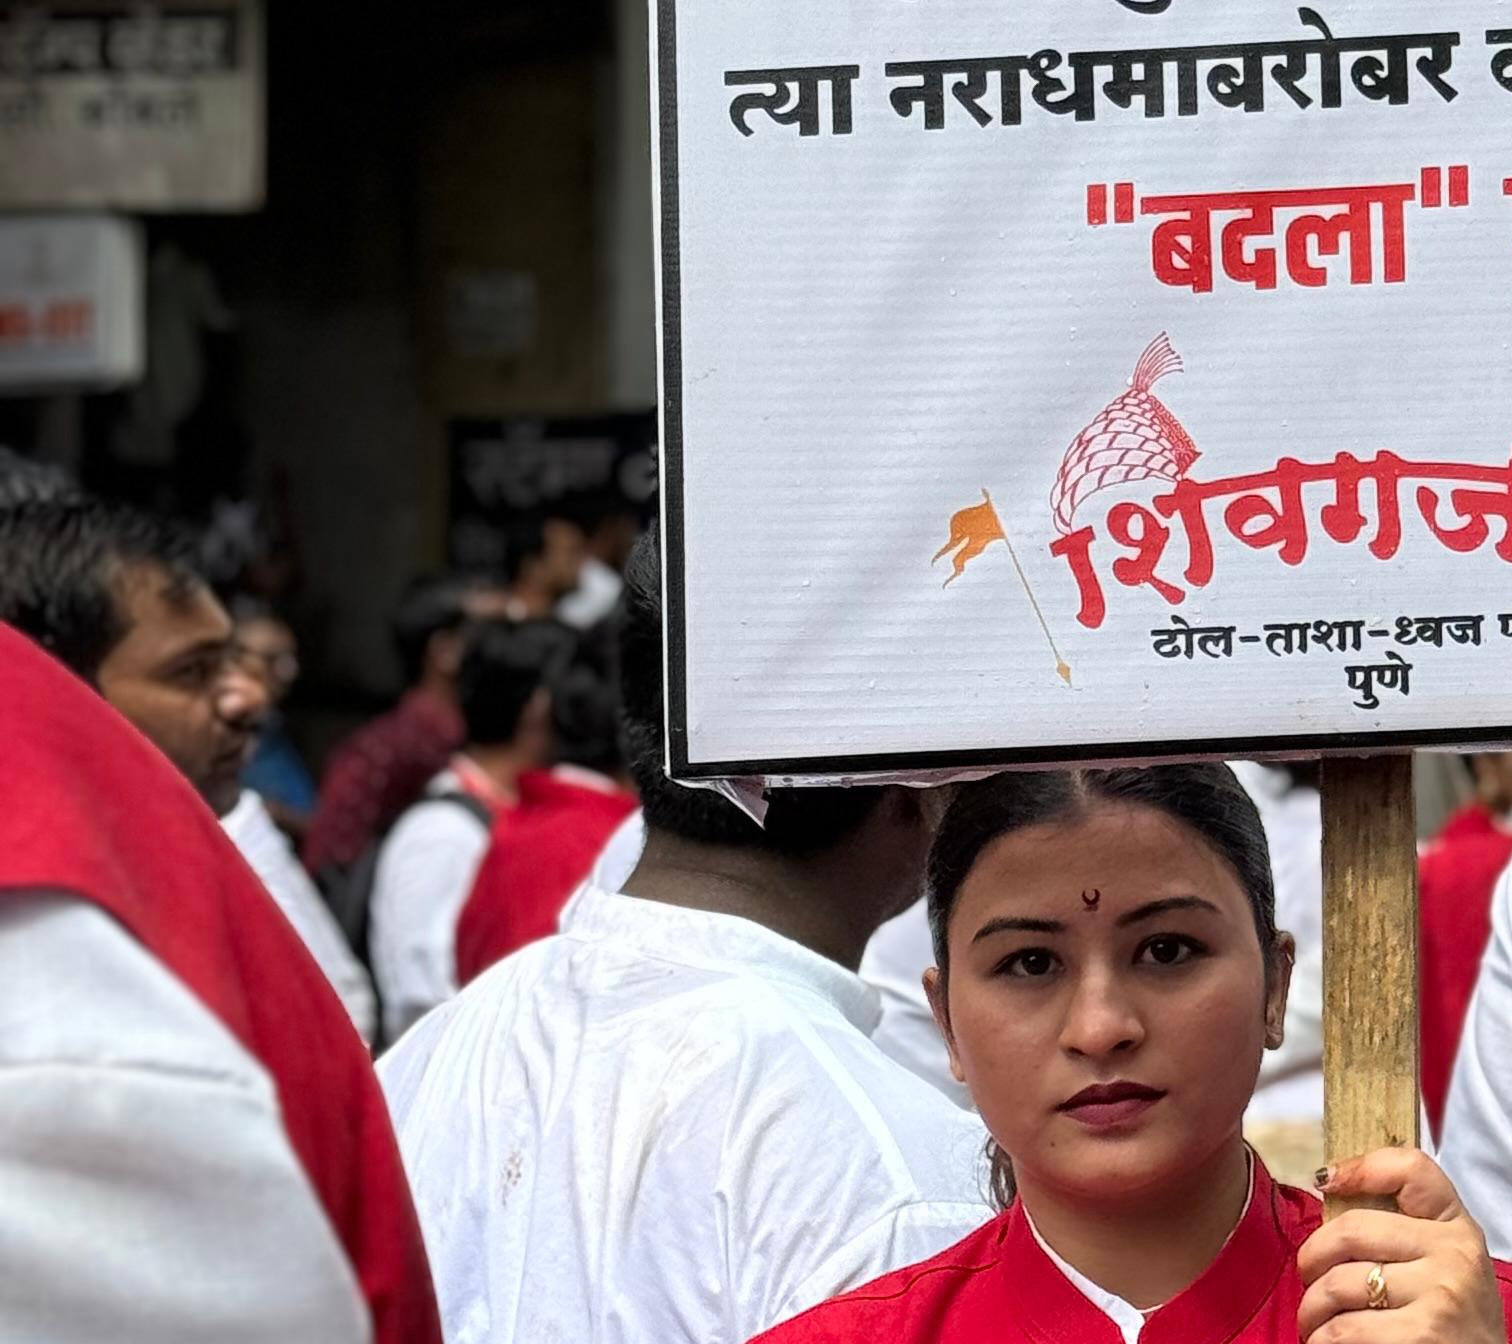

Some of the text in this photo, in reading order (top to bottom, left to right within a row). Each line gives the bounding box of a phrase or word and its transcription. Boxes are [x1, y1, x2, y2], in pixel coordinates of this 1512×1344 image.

[724, 64, 860, 137] त्या
[884, 7, 1461, 130] नराधमाबरोबर
[1087, 164, 1469, 293] "बदला"
[1344, 651, 1414, 709] पुणे
